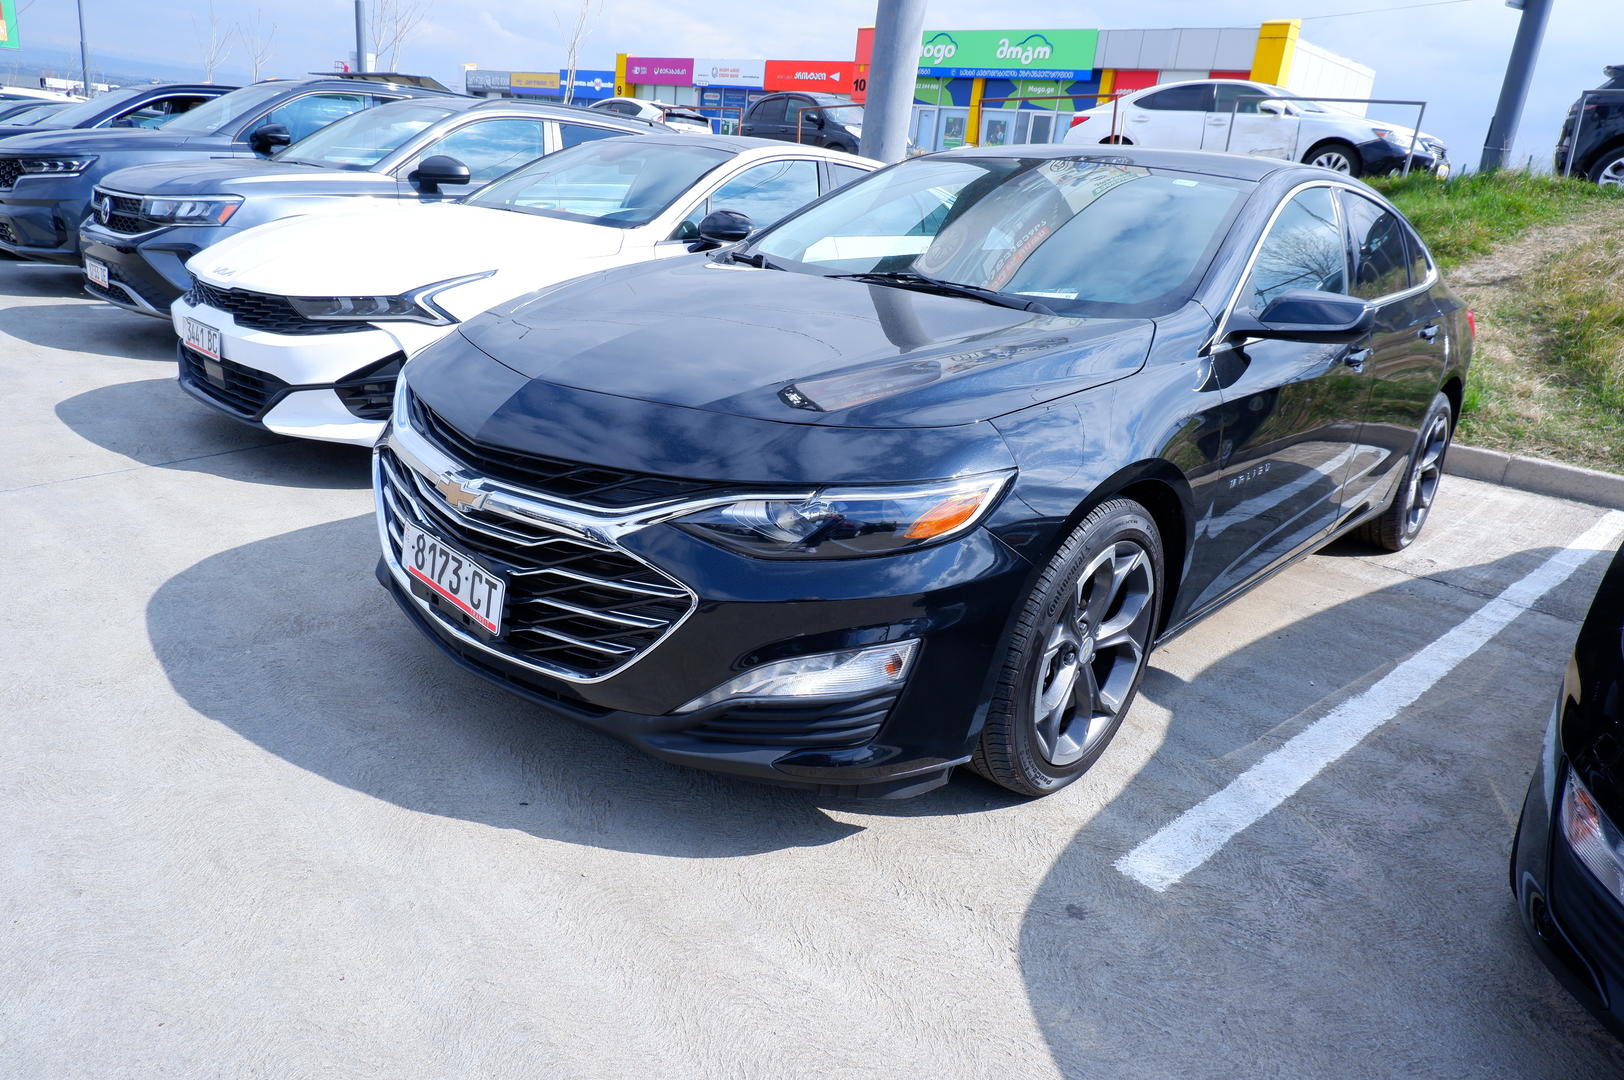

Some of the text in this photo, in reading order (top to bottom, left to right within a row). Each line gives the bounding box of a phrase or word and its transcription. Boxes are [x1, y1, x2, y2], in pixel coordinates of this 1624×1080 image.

[918, 44, 956, 65] ogo
[617, 85, 623, 96] 9
[853, 79, 866, 92] 10
[207, 330, 218, 354] BC
[414, 533, 498, 619] 8173 CT
[1047, 550, 1085, 618] Continental
